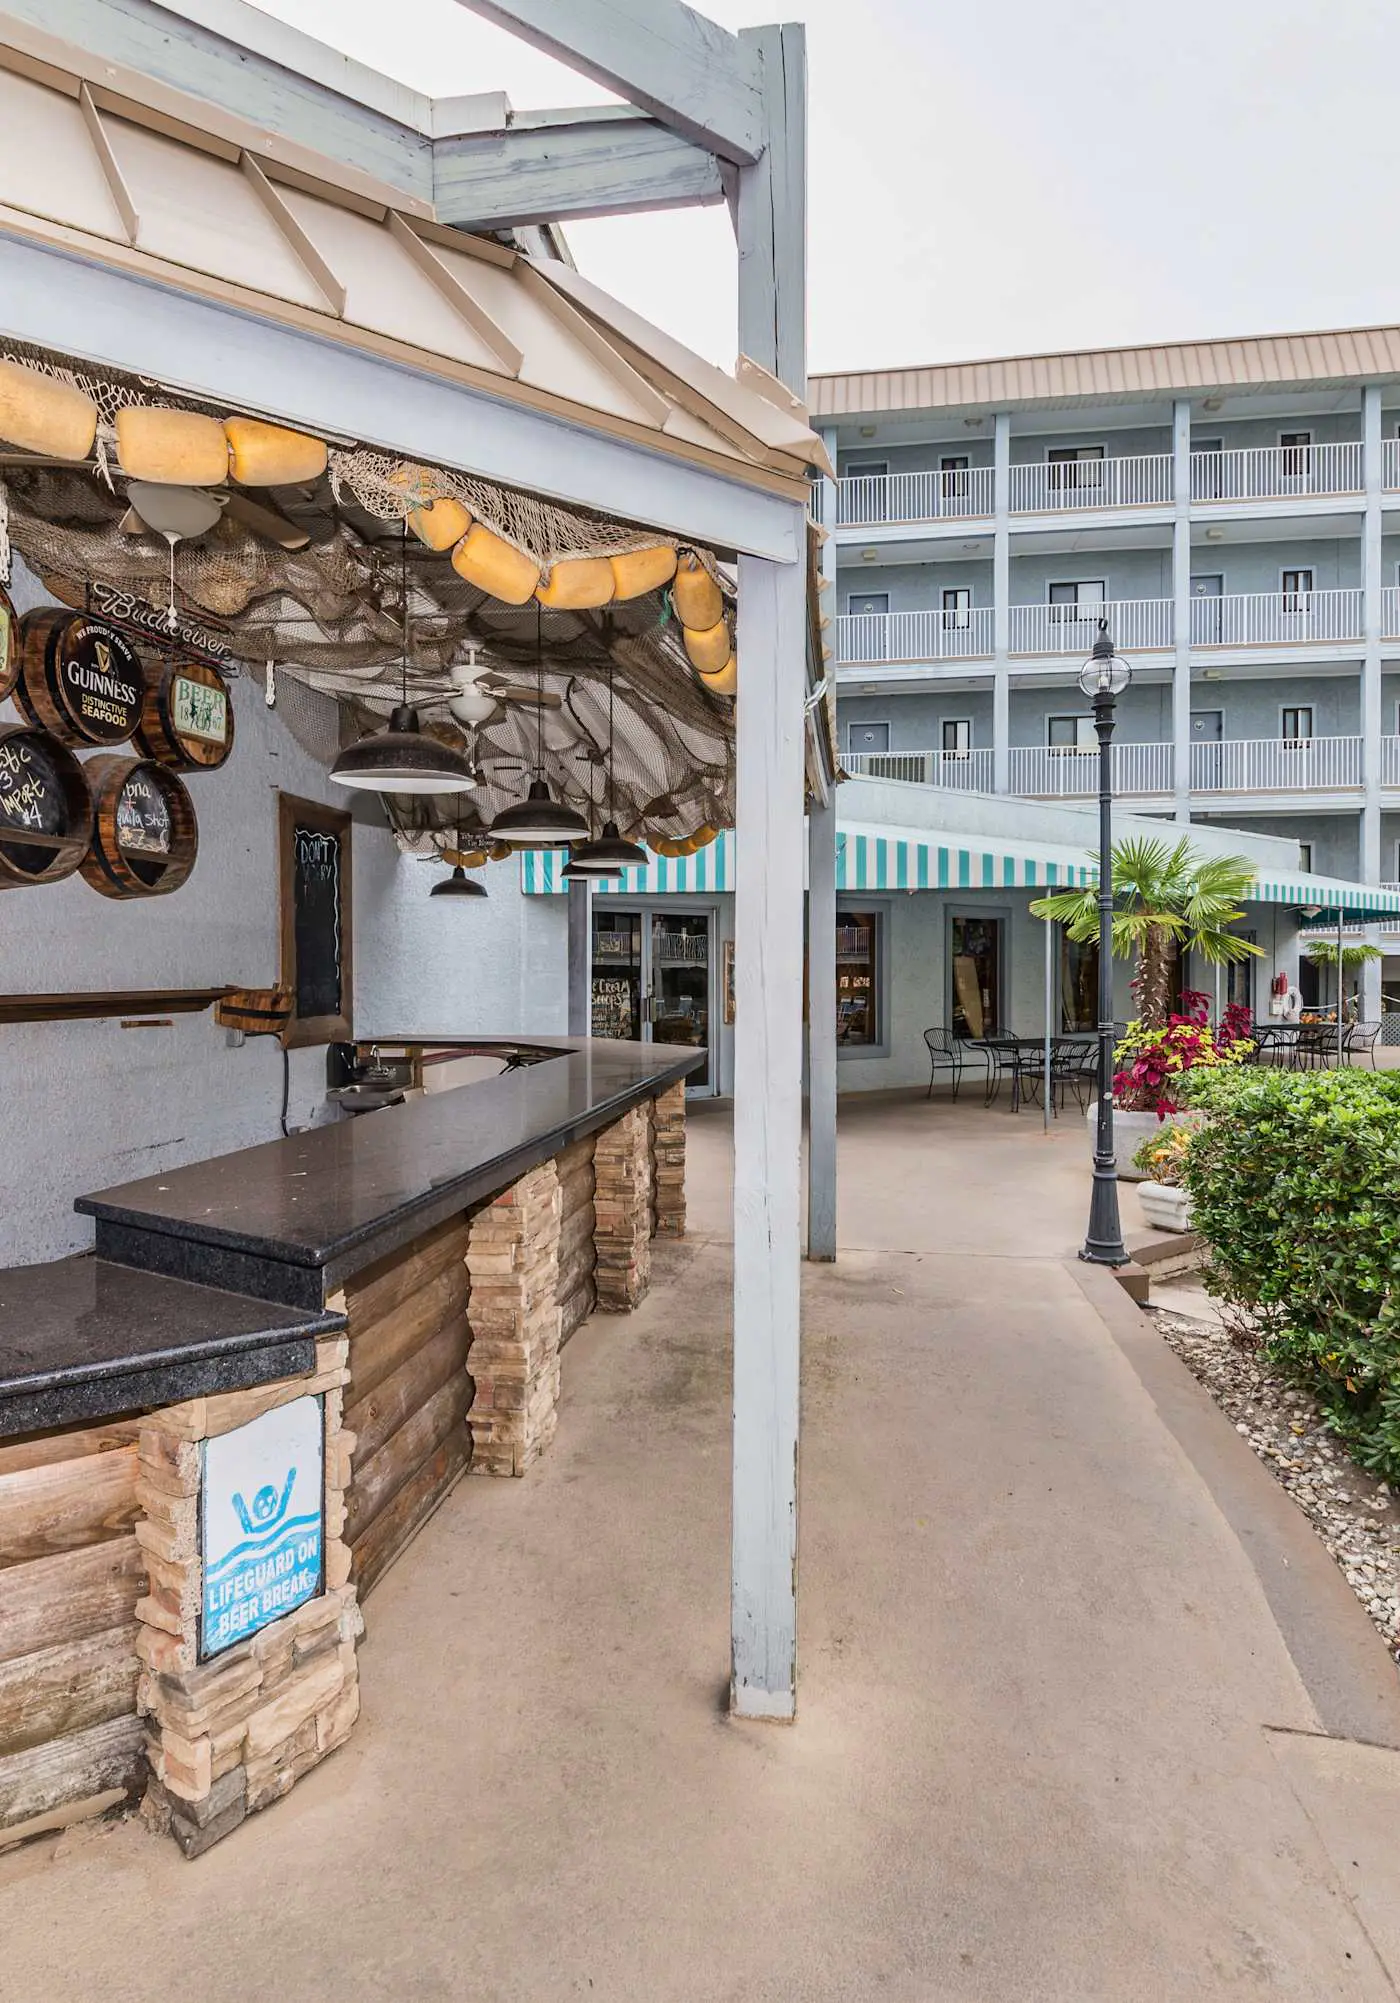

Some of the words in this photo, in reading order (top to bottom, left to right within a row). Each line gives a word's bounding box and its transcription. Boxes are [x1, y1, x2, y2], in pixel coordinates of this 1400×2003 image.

[94, 581, 232, 661] Budweiser
[76, 627, 87, 640] WE
[113, 636, 133, 662] SERVE
[67, 660, 136, 705] GUINNESS
[178, 680, 225, 713] BEER
[81, 693, 128, 717] DISTINCTIVE
[81, 703, 127, 727] SEAFOOD
[208, 1549, 295, 1611] LIFEGUARD
[298, 1536, 318, 1565] ON
[218, 1597, 260, 1638] BEER
[262, 1567, 309, 1612] BREAK
